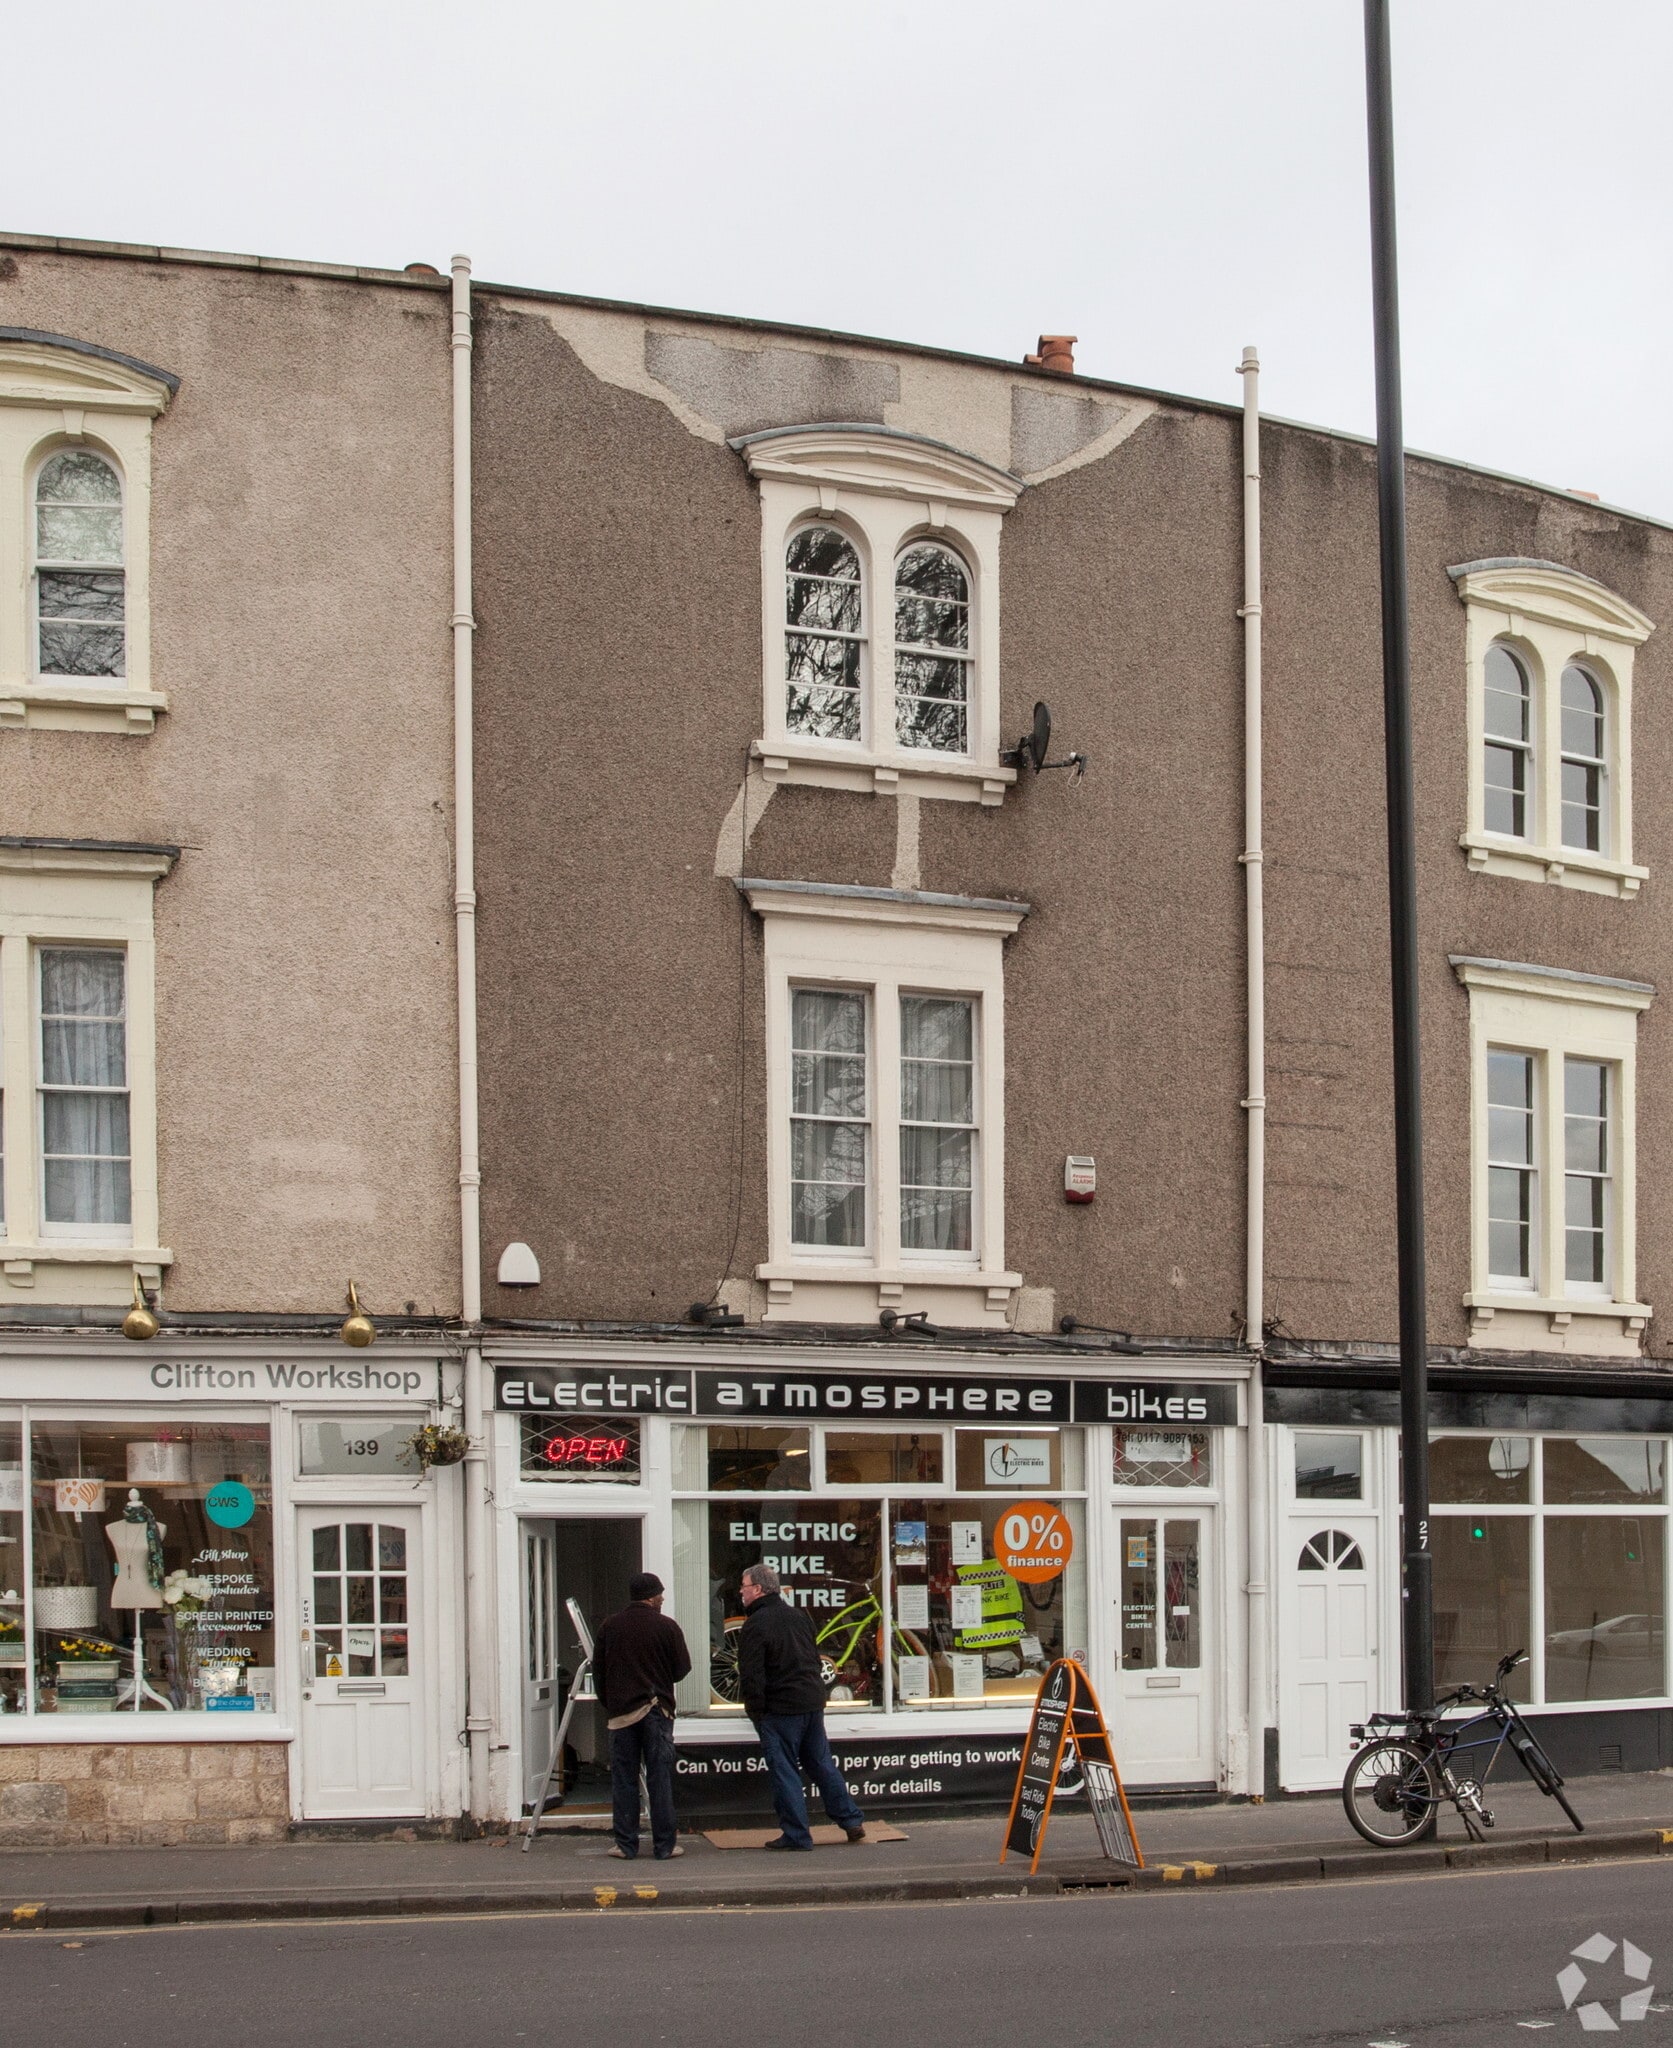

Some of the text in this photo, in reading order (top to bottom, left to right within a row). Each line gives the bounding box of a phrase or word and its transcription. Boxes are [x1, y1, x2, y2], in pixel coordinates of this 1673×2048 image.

[150, 1363, 422, 1395] Clifton Workshop
[1137, 1433, 1160, 1443] 0117
[344, 1439, 378, 1455] 139
[547, 1439, 626, 1460] OPEN
[208, 1497, 239, 1507] CWS
[729, 1522, 857, 1542] ELECTRIC
[1004, 1515, 1063, 1550] 0%
[763, 1555, 825, 1575] BIKE
[1007, 1555, 1062, 1567] finance
[780, 1589, 846, 1607] NTRE
[176, 1611, 274, 1621] SCREEN PRINTED
[1123, 1604, 1156, 1612] ELECTRIC
[196, 1647, 251, 1657] WEDDING
[1038, 1716, 1059, 1733] Electric
[1038, 1735, 1050, 1750] Bike
[676, 1759, 708, 1774] Can
[712, 1758, 742, 1773] You
[843, 1755, 869, 1771] per
[873, 1754, 906, 1770] year
[910, 1750, 962, 1768] getting
[966, 1750, 981, 1763] to
[984, 1747, 1021, 1762] work
[1031, 1752, 1050, 1769] Centre
[863, 1781, 885, 1795] for
[889, 1778, 942, 1794] details
[1021, 1785, 1046, 1804] Test Ride
[1021, 1804, 1037, 1824] Today
